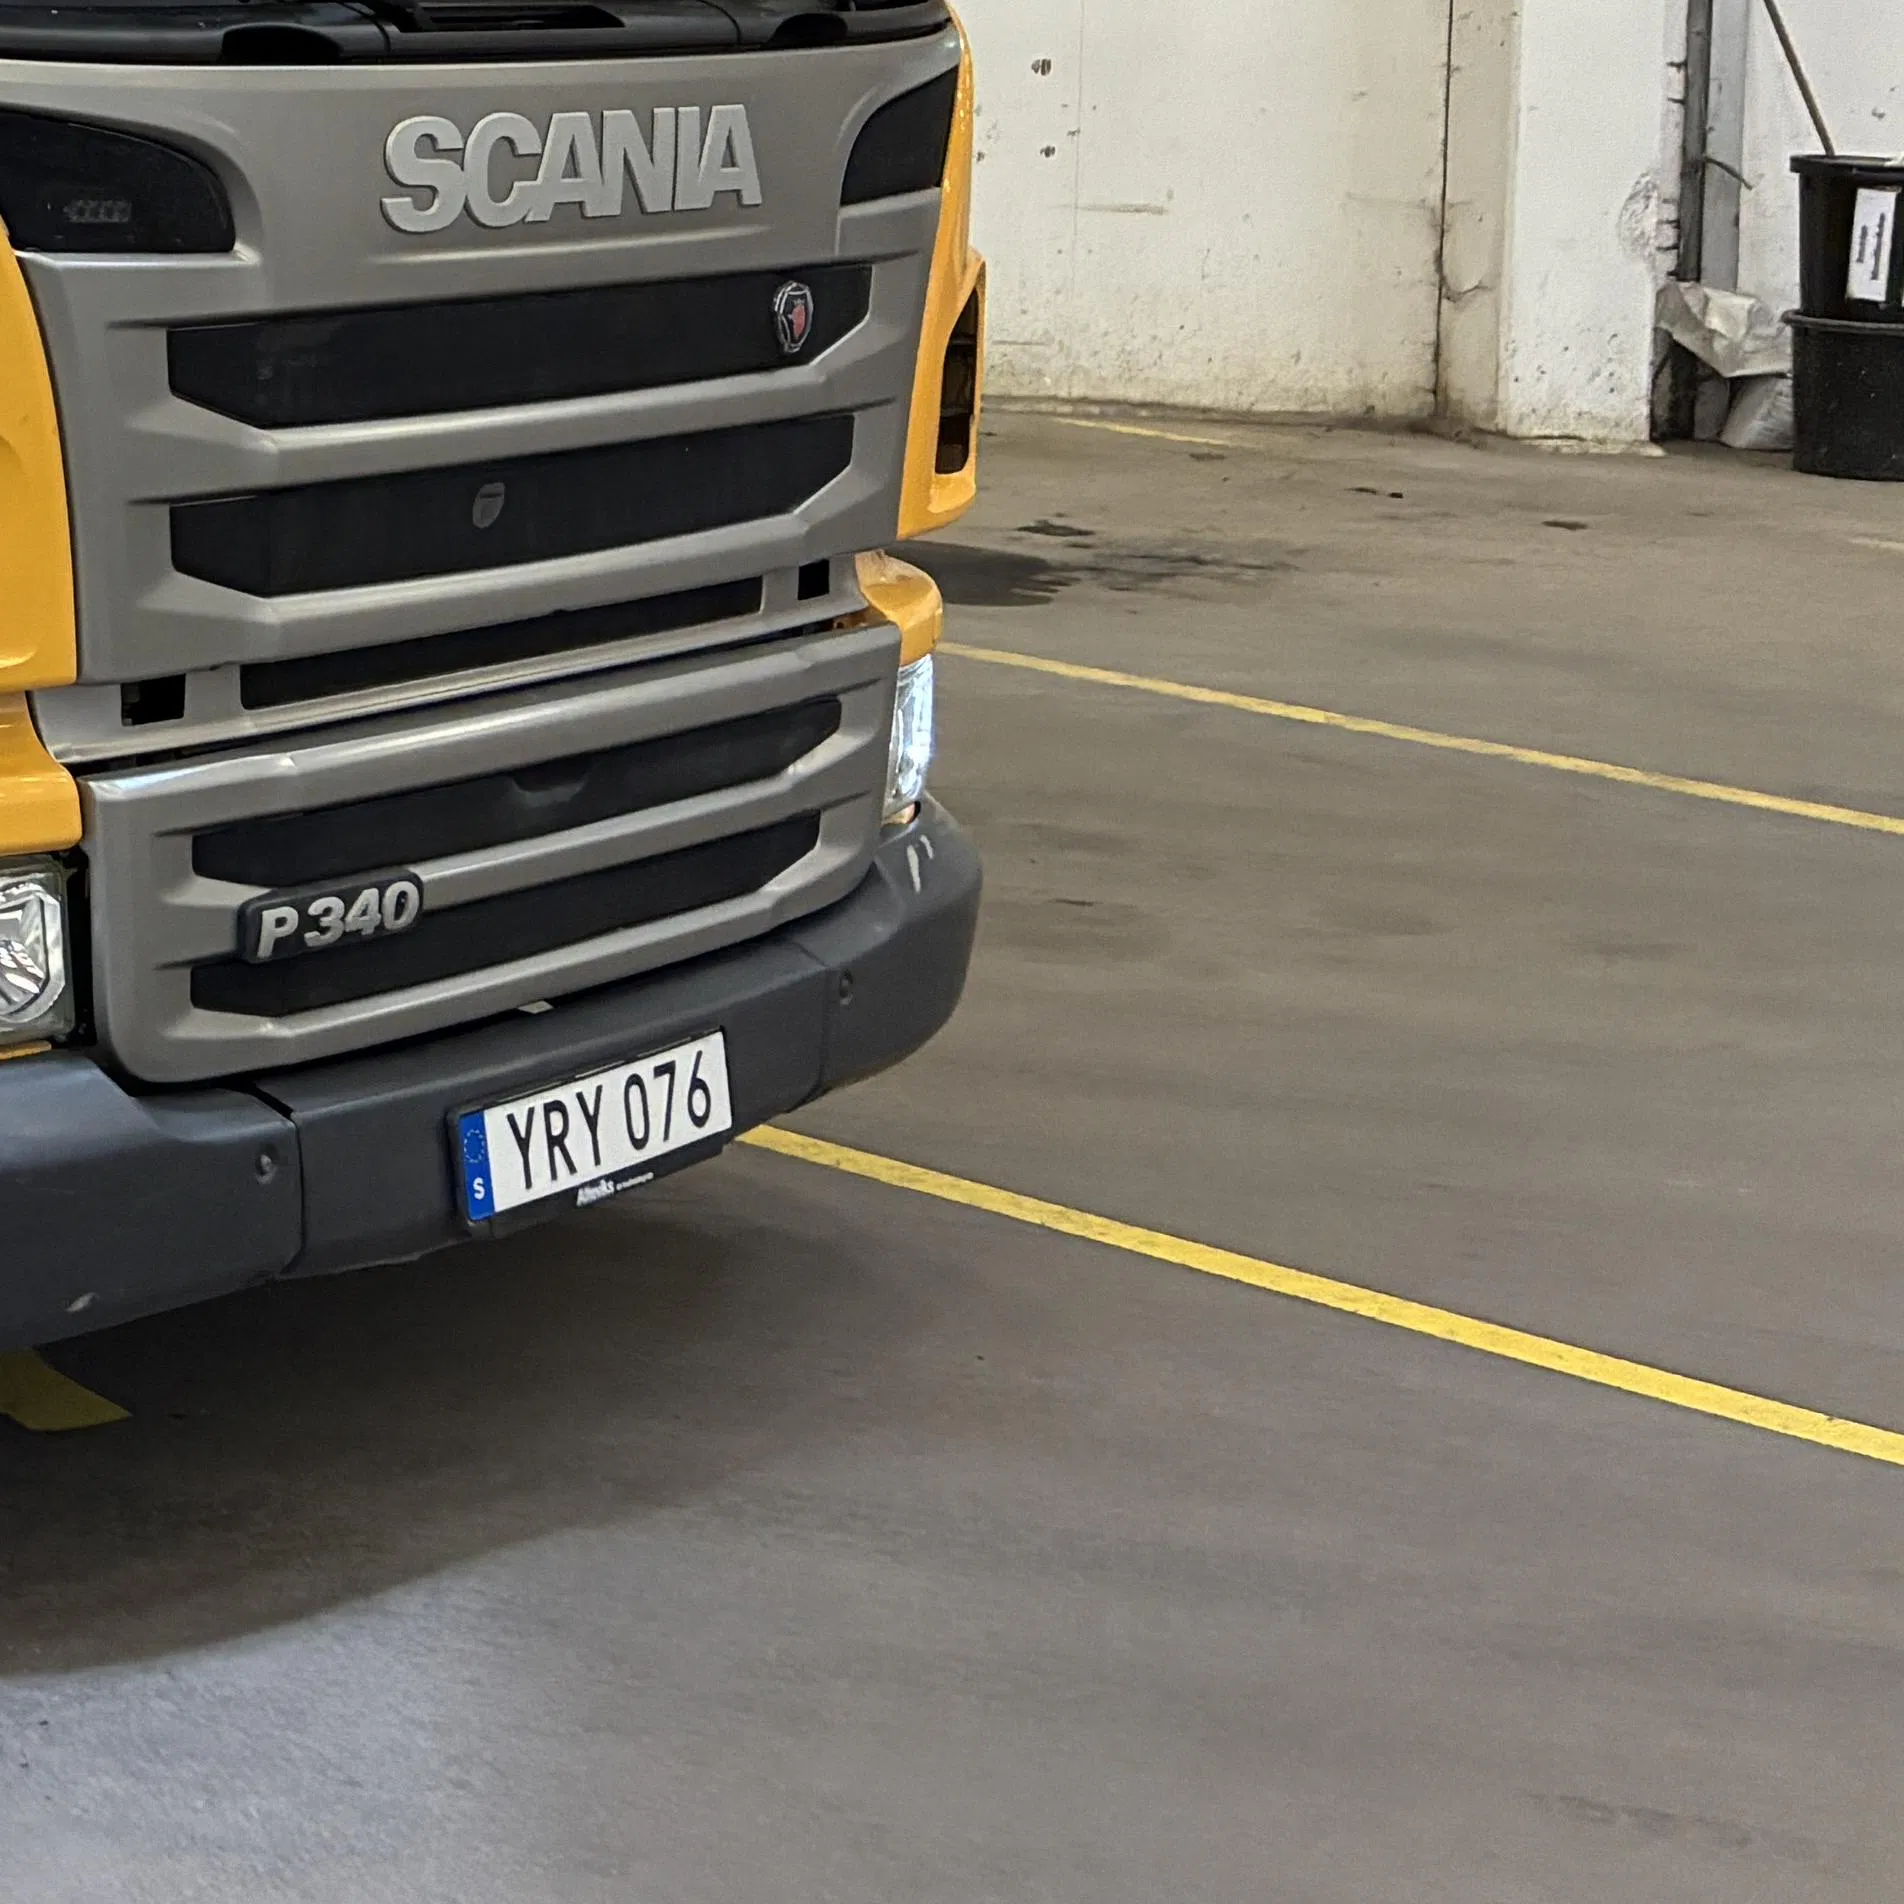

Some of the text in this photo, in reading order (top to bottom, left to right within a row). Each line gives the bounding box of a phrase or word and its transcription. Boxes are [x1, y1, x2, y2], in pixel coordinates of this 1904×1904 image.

[380, 103, 763, 233] SCANIA
[506, 1050, 711, 1190] YRY 076
[472, 1176, 486, 1201] S
